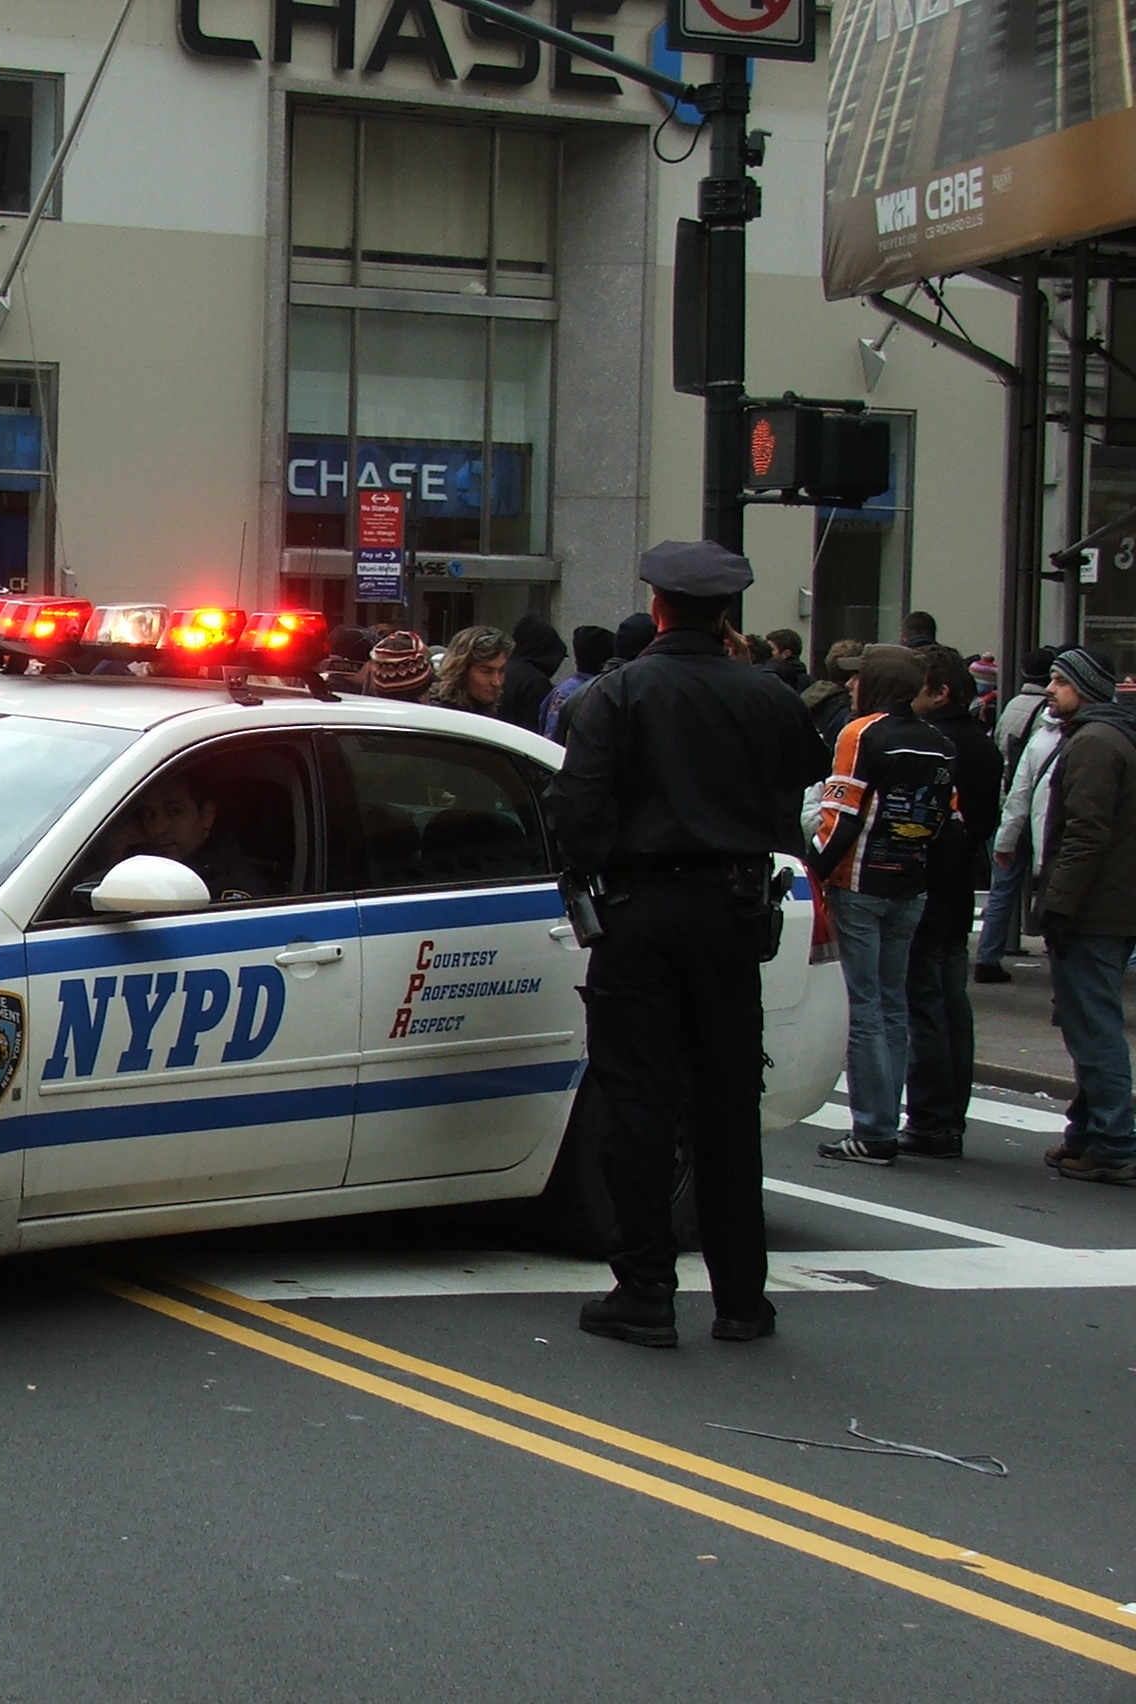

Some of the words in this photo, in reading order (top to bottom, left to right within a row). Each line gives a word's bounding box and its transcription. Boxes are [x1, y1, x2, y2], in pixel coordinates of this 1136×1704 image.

[925, 166, 983, 220] CBRE
[935, 218, 964, 237] RICHARD
[966, 213, 983, 229] ELLIS
[371, 505, 399, 513] Standing
[824, 784, 846, 799] 76
[416, 940, 498, 971] COURTESY
[403, 973, 542, 1005] PROFESSIONALISM
[41, 964, 286, 1081] NYPD
[388, 1007, 465, 1039] RESPECT
[0, 1064, 14, 1089] NEW
[12, 1030, 22, 1060] YORK
